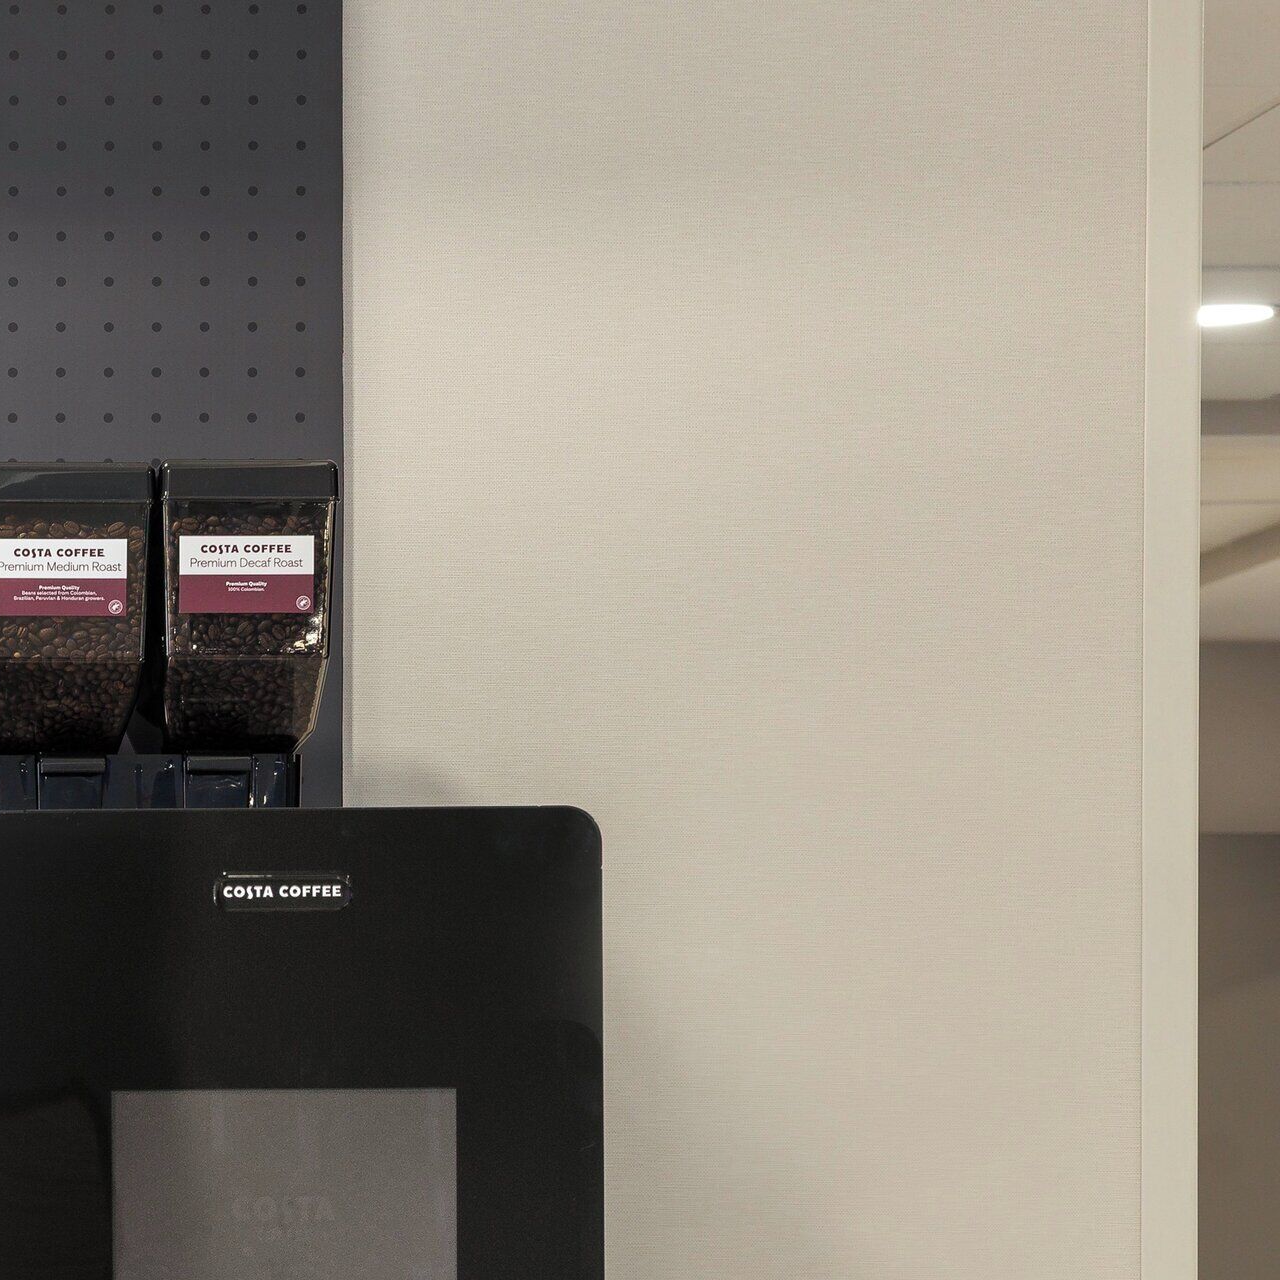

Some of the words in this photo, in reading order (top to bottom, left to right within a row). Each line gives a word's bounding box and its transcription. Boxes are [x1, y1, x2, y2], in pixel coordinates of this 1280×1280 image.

[13, 548, 52, 558] COSTA
[56, 548, 105, 557] COFFEE
[200, 544, 239, 554] COSTA
[243, 544, 292, 553] COFFEE
[46, 561, 89, 572] Medium
[91, 561, 122, 572] Roast
[189, 557, 237, 568] Premium
[239, 557, 271, 568] Decaf
[273, 557, 304, 568] Roast
[223, 885, 274, 900] COSTA
[278, 885, 342, 898] COFFEE
